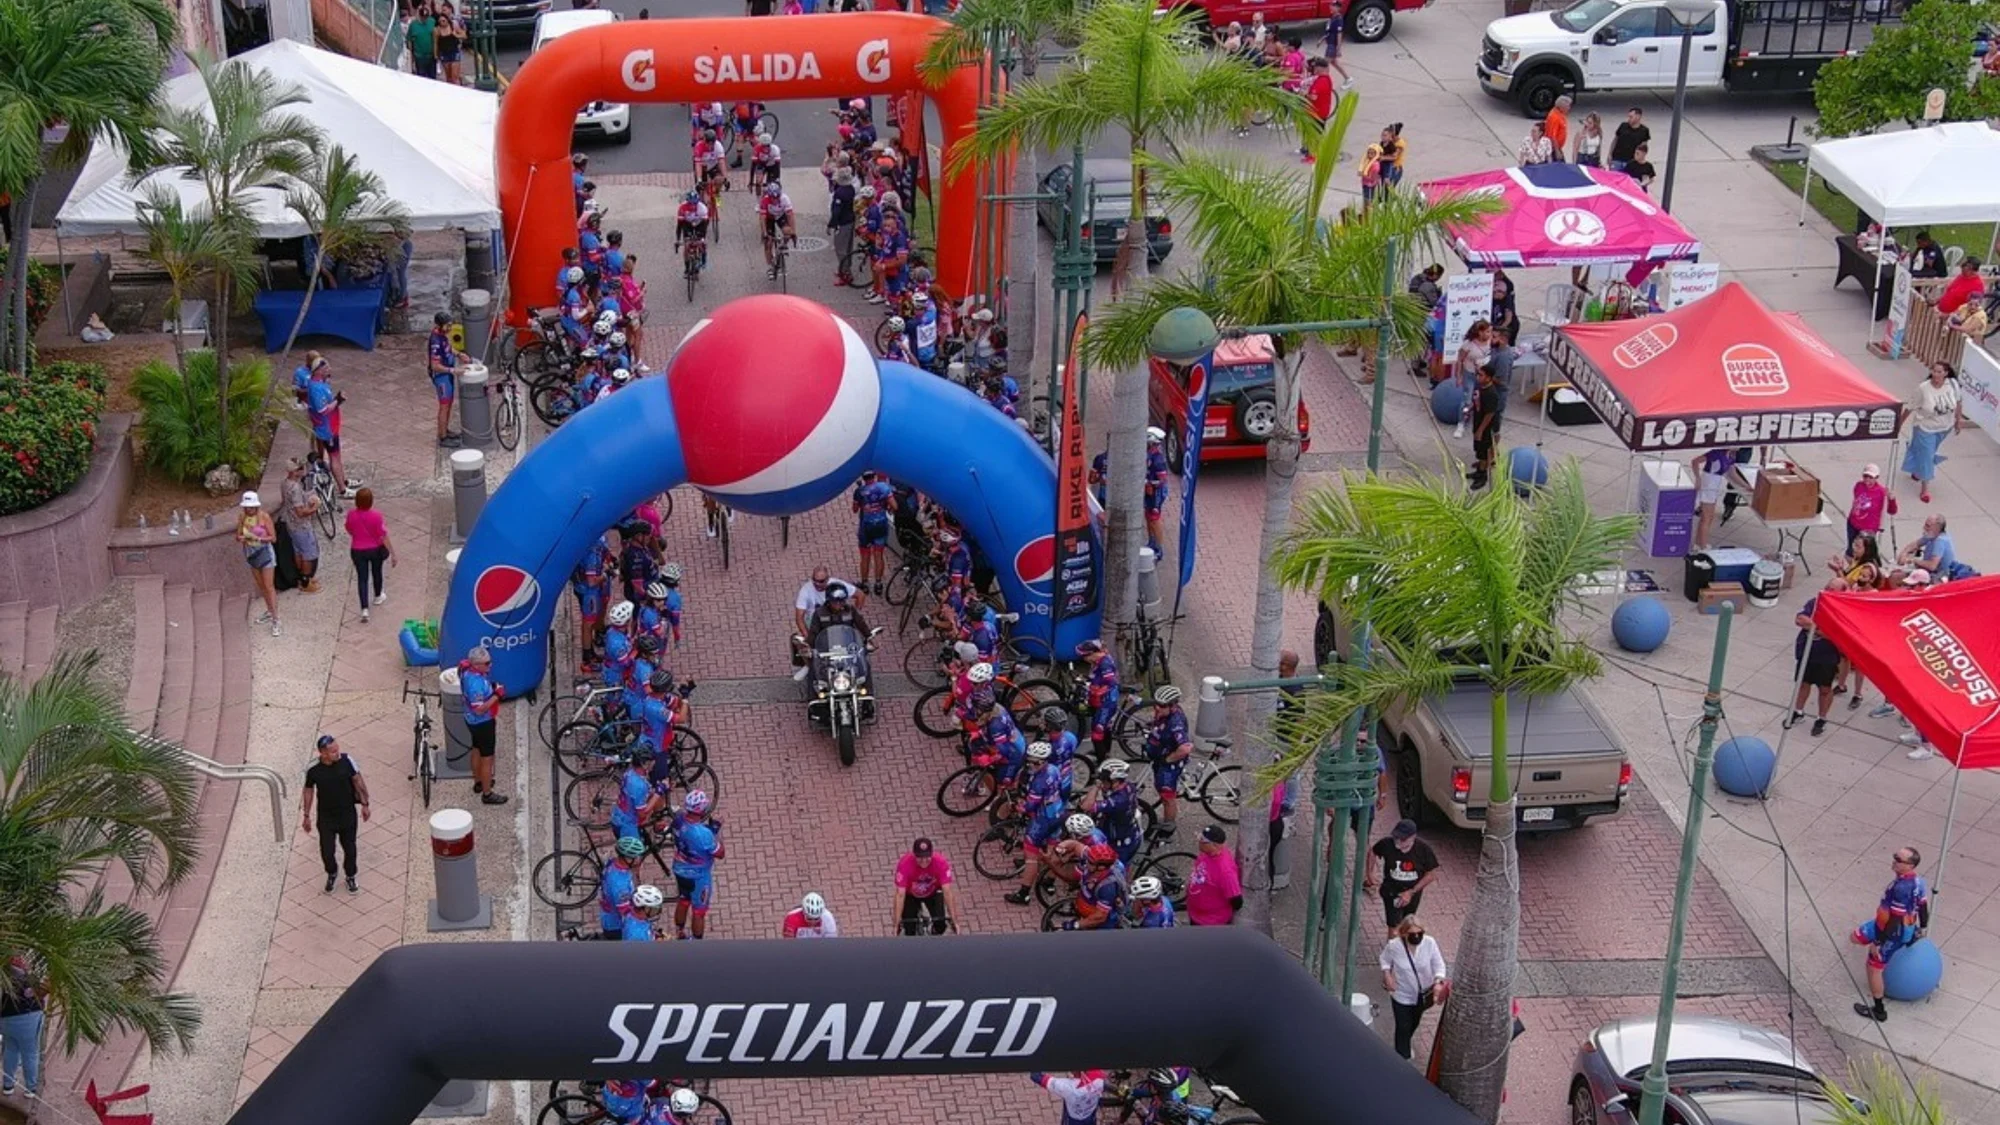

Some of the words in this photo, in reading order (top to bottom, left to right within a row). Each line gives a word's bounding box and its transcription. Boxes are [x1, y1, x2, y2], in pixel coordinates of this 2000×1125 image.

[694, 52, 821, 83] SALIDA
[1458, 296, 1483, 304] MENU
[1680, 285, 1707, 293] MENU
[1727, 361, 1780, 373] BURGER
[1729, 372, 1784, 386] KING
[1642, 419, 1687, 447] LO
[1692, 411, 1859, 444] PREFIERO
[480, 628, 537, 651] pepsi
[1900, 612, 1998, 705] FIREHOUSE
[1917, 645, 1955, 679] SUBS
[1518, 793, 1586, 801] ACOMA
[593, 997, 1057, 1063] SPECIALIZED
